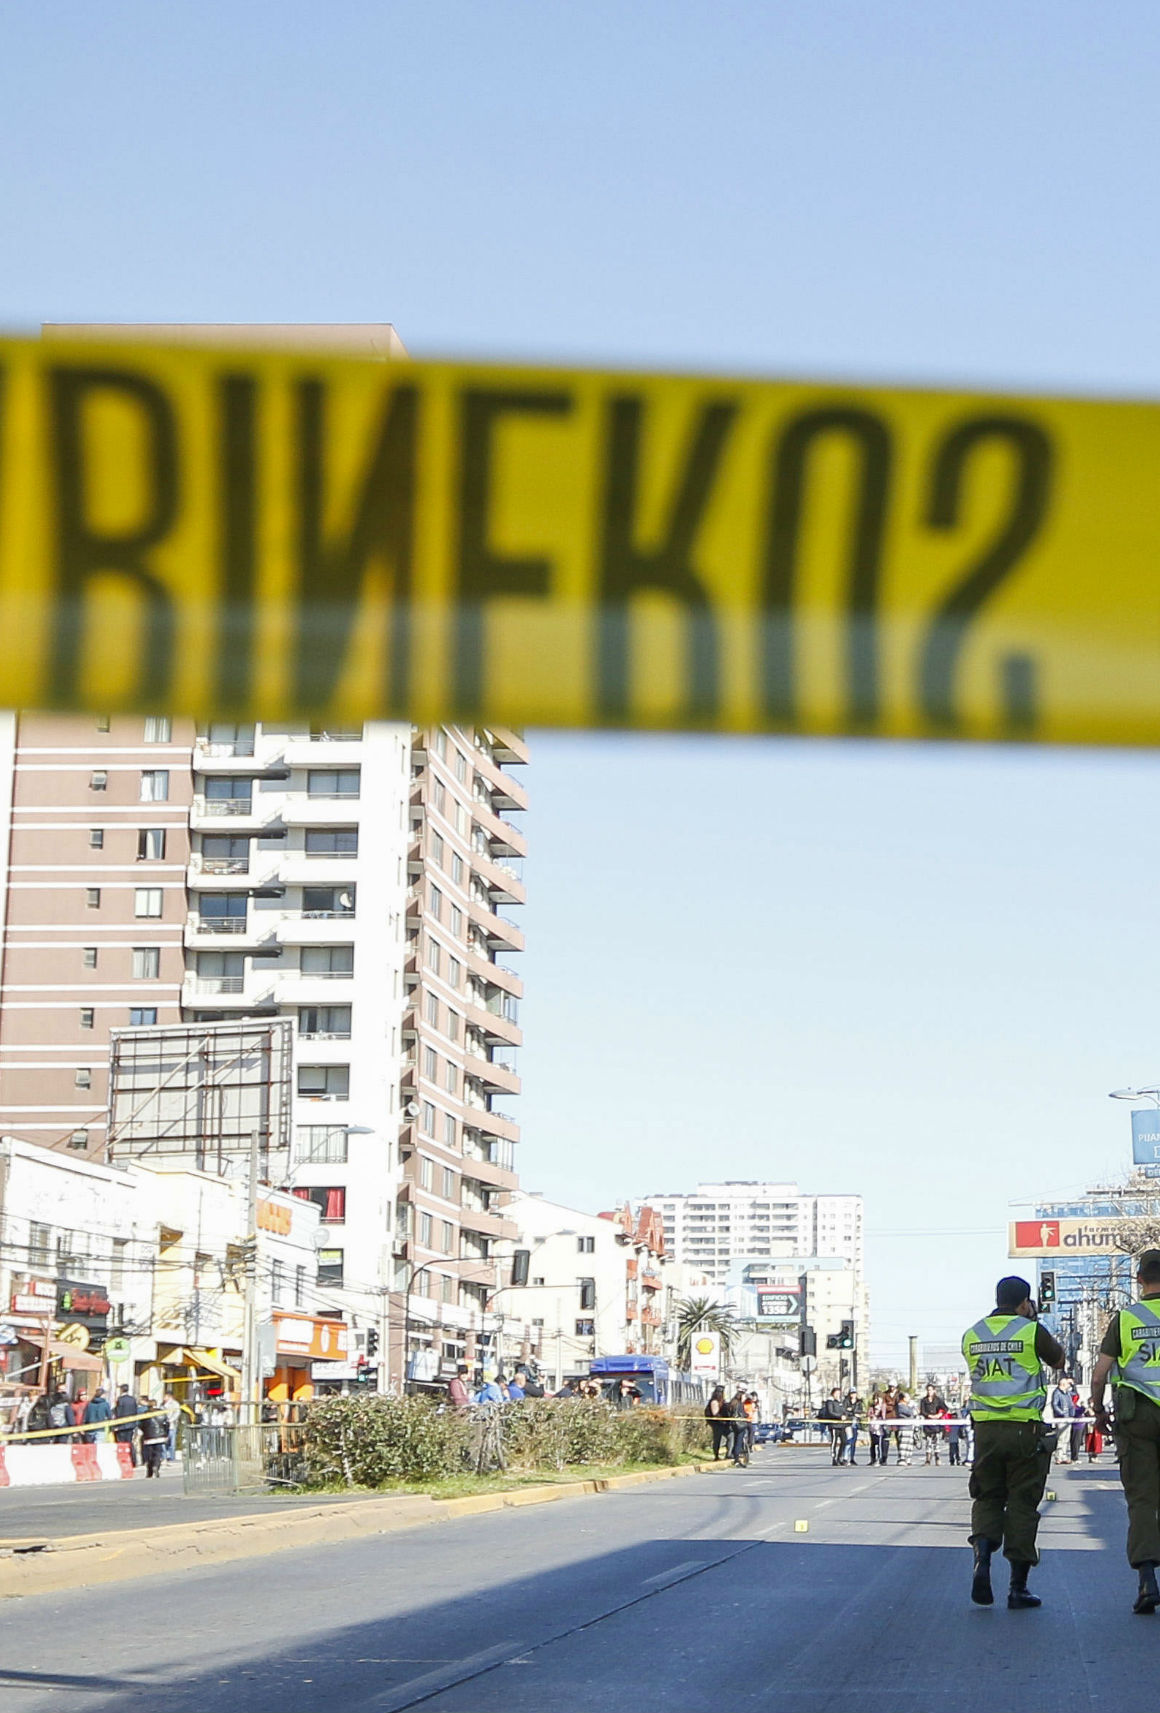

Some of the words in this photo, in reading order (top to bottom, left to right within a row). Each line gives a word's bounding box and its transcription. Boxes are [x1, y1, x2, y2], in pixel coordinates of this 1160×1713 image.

[1000, 1342, 1008, 1352] DE
[1008, 1341, 1022, 1351] CHILE
[973, 1358, 1016, 1377] SIAT
